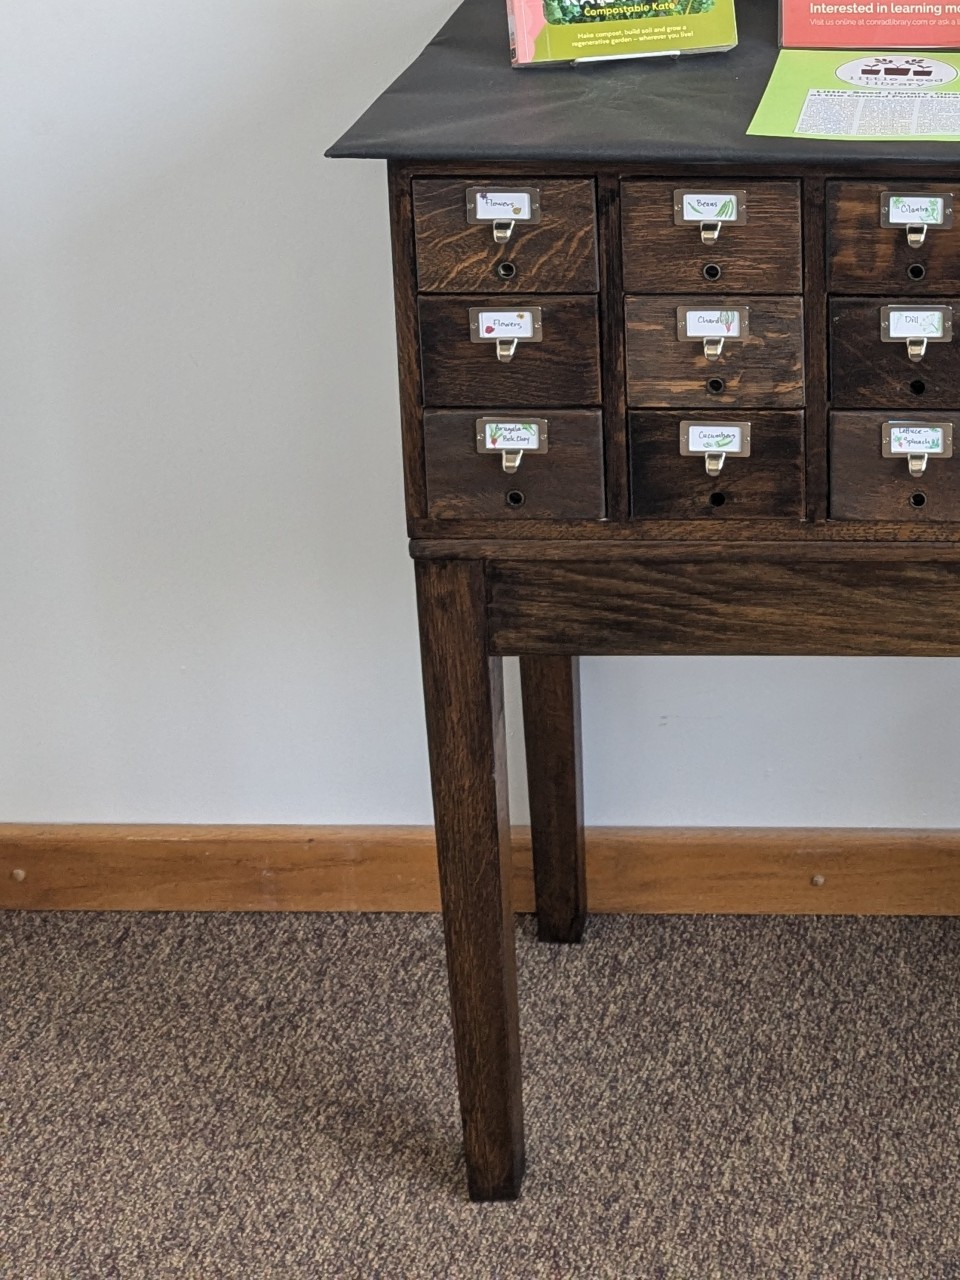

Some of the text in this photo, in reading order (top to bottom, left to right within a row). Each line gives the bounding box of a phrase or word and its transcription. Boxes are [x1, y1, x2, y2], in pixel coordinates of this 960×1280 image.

[583, 2, 676, 17] Compostable Kate
[809, 3, 874, 14] Interested
[876, 3, 888, 14] in
[890, 3, 942, 16] learning
[809, 18, 825, 26] Visit
[835, 18, 857, 26] online
[865, 18, 928, 27] conradlibrary.com
[937, 18, 950, 26] ask
[577, 32, 594, 40] Make
[595, 30, 623, 39] compost,
[624, 28, 640, 36] build
[571, 39, 610, 48] regenerative
[610, 37, 632, 45] garden
[638, 34, 667, 42] wherever
[485, 198, 515, 208] Flowers
[696, 198, 718, 208] Beans
[900, 204, 929, 214] Cilantro
[493, 318, 522, 329] Flowers
[697, 315, 720, 324] Chard
[904, 315, 919, 324] Dill
[495, 424, 521, 434] Arugula
[898, 427, 922, 435] Lettuce
[698, 430, 736, 440] Cucumbers
[903, 436, 931, 447] Spinach
